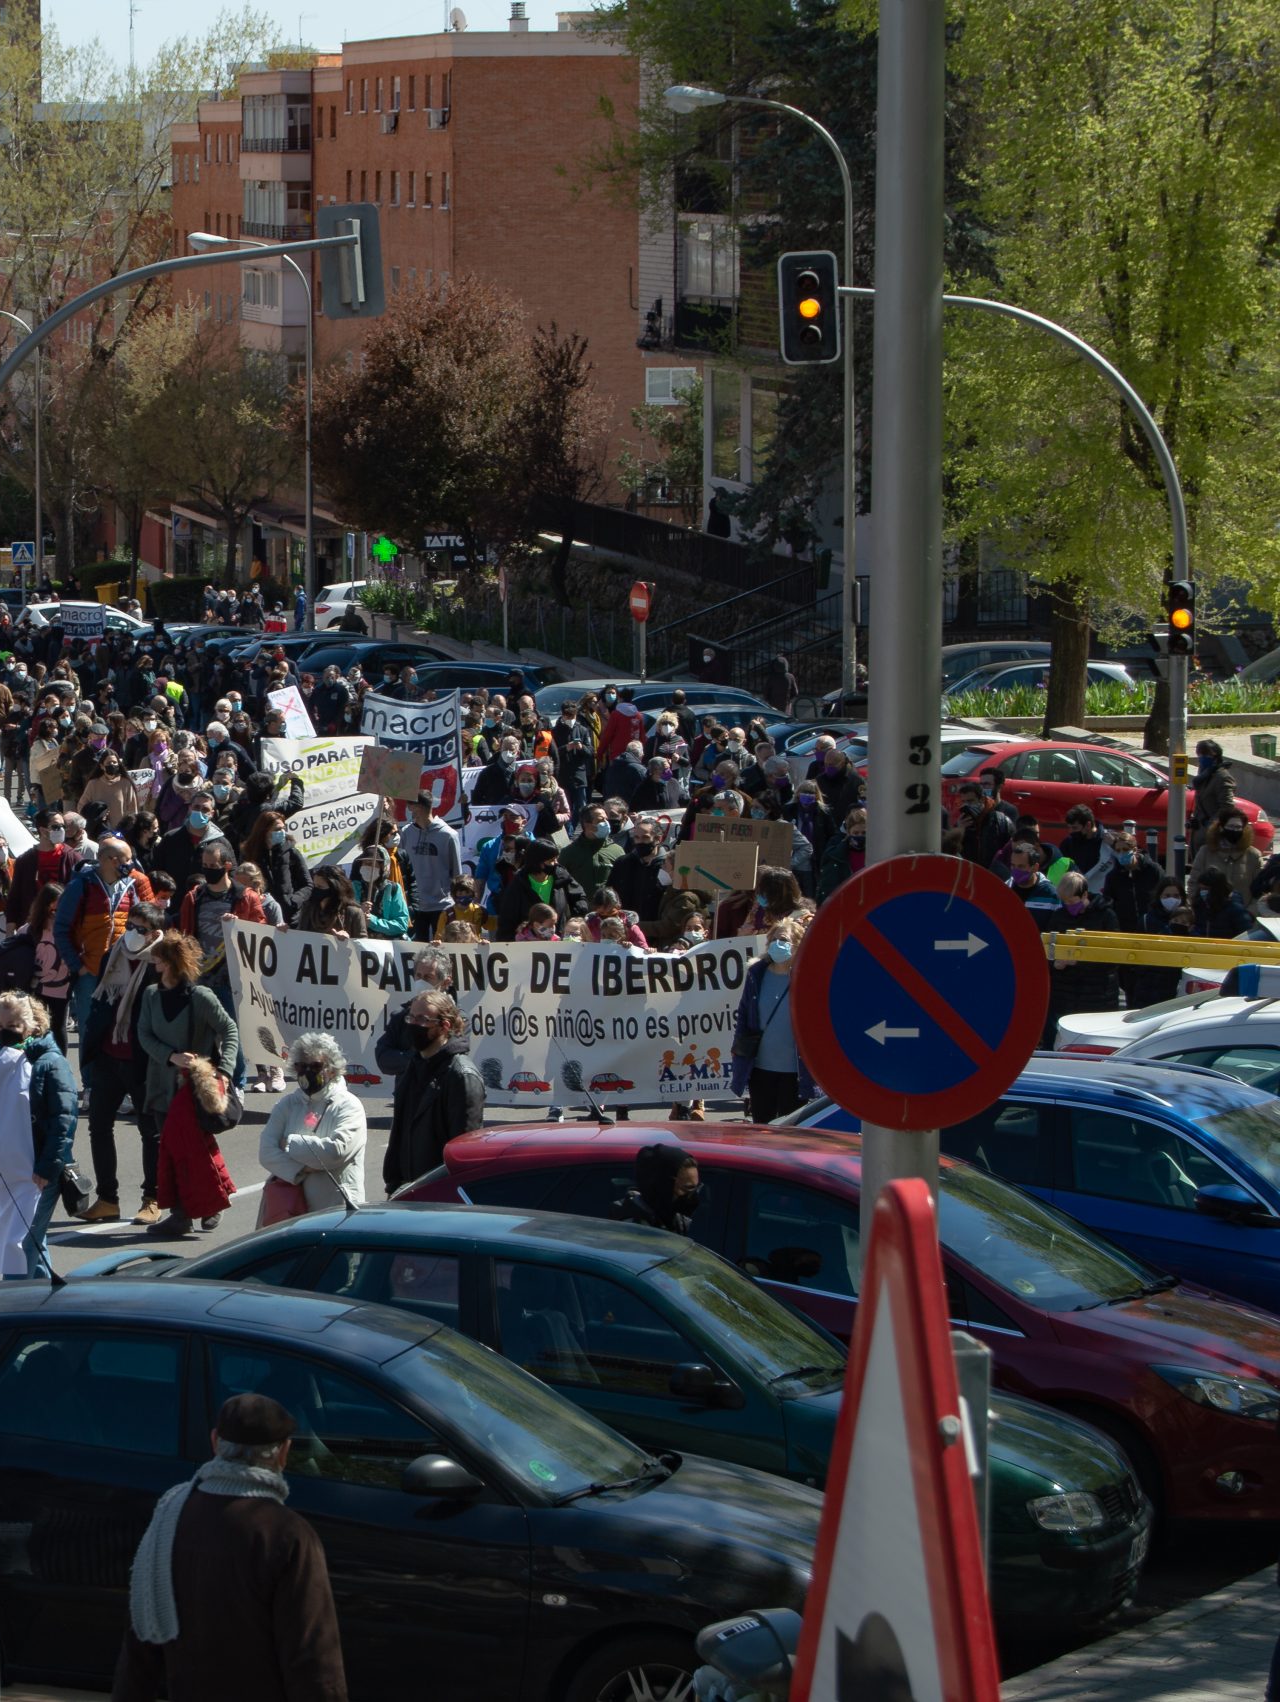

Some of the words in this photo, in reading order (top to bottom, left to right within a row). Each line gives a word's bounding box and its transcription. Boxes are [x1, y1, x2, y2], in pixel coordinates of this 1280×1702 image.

[61, 609, 102, 621] macro
[363, 705, 456, 735] macro
[269, 759, 304, 775] USO
[307, 747, 350, 769] PARA
[302, 815, 317, 828] AL
[320, 801, 375, 822] PARKING
[303, 826, 319, 839] DE
[322, 816, 358, 834] PAGO
[237, 931, 277, 977] NO
[296, 943, 339, 985] AL
[360, 951, 509, 993] PARING
[530, 952, 572, 994] DE
[592, 946, 754, 996] IBERDRO
[250, 982, 375, 1037] Ayuntamiento,
[472, 1005, 495, 1036] de
[502, 1007, 539, 1045] l@s
[545, 1009, 606, 1047] niñ@s
[613, 1010, 638, 1039] no
[645, 1014, 670, 1039] es
[696, 1081, 720, 1092] Juan
